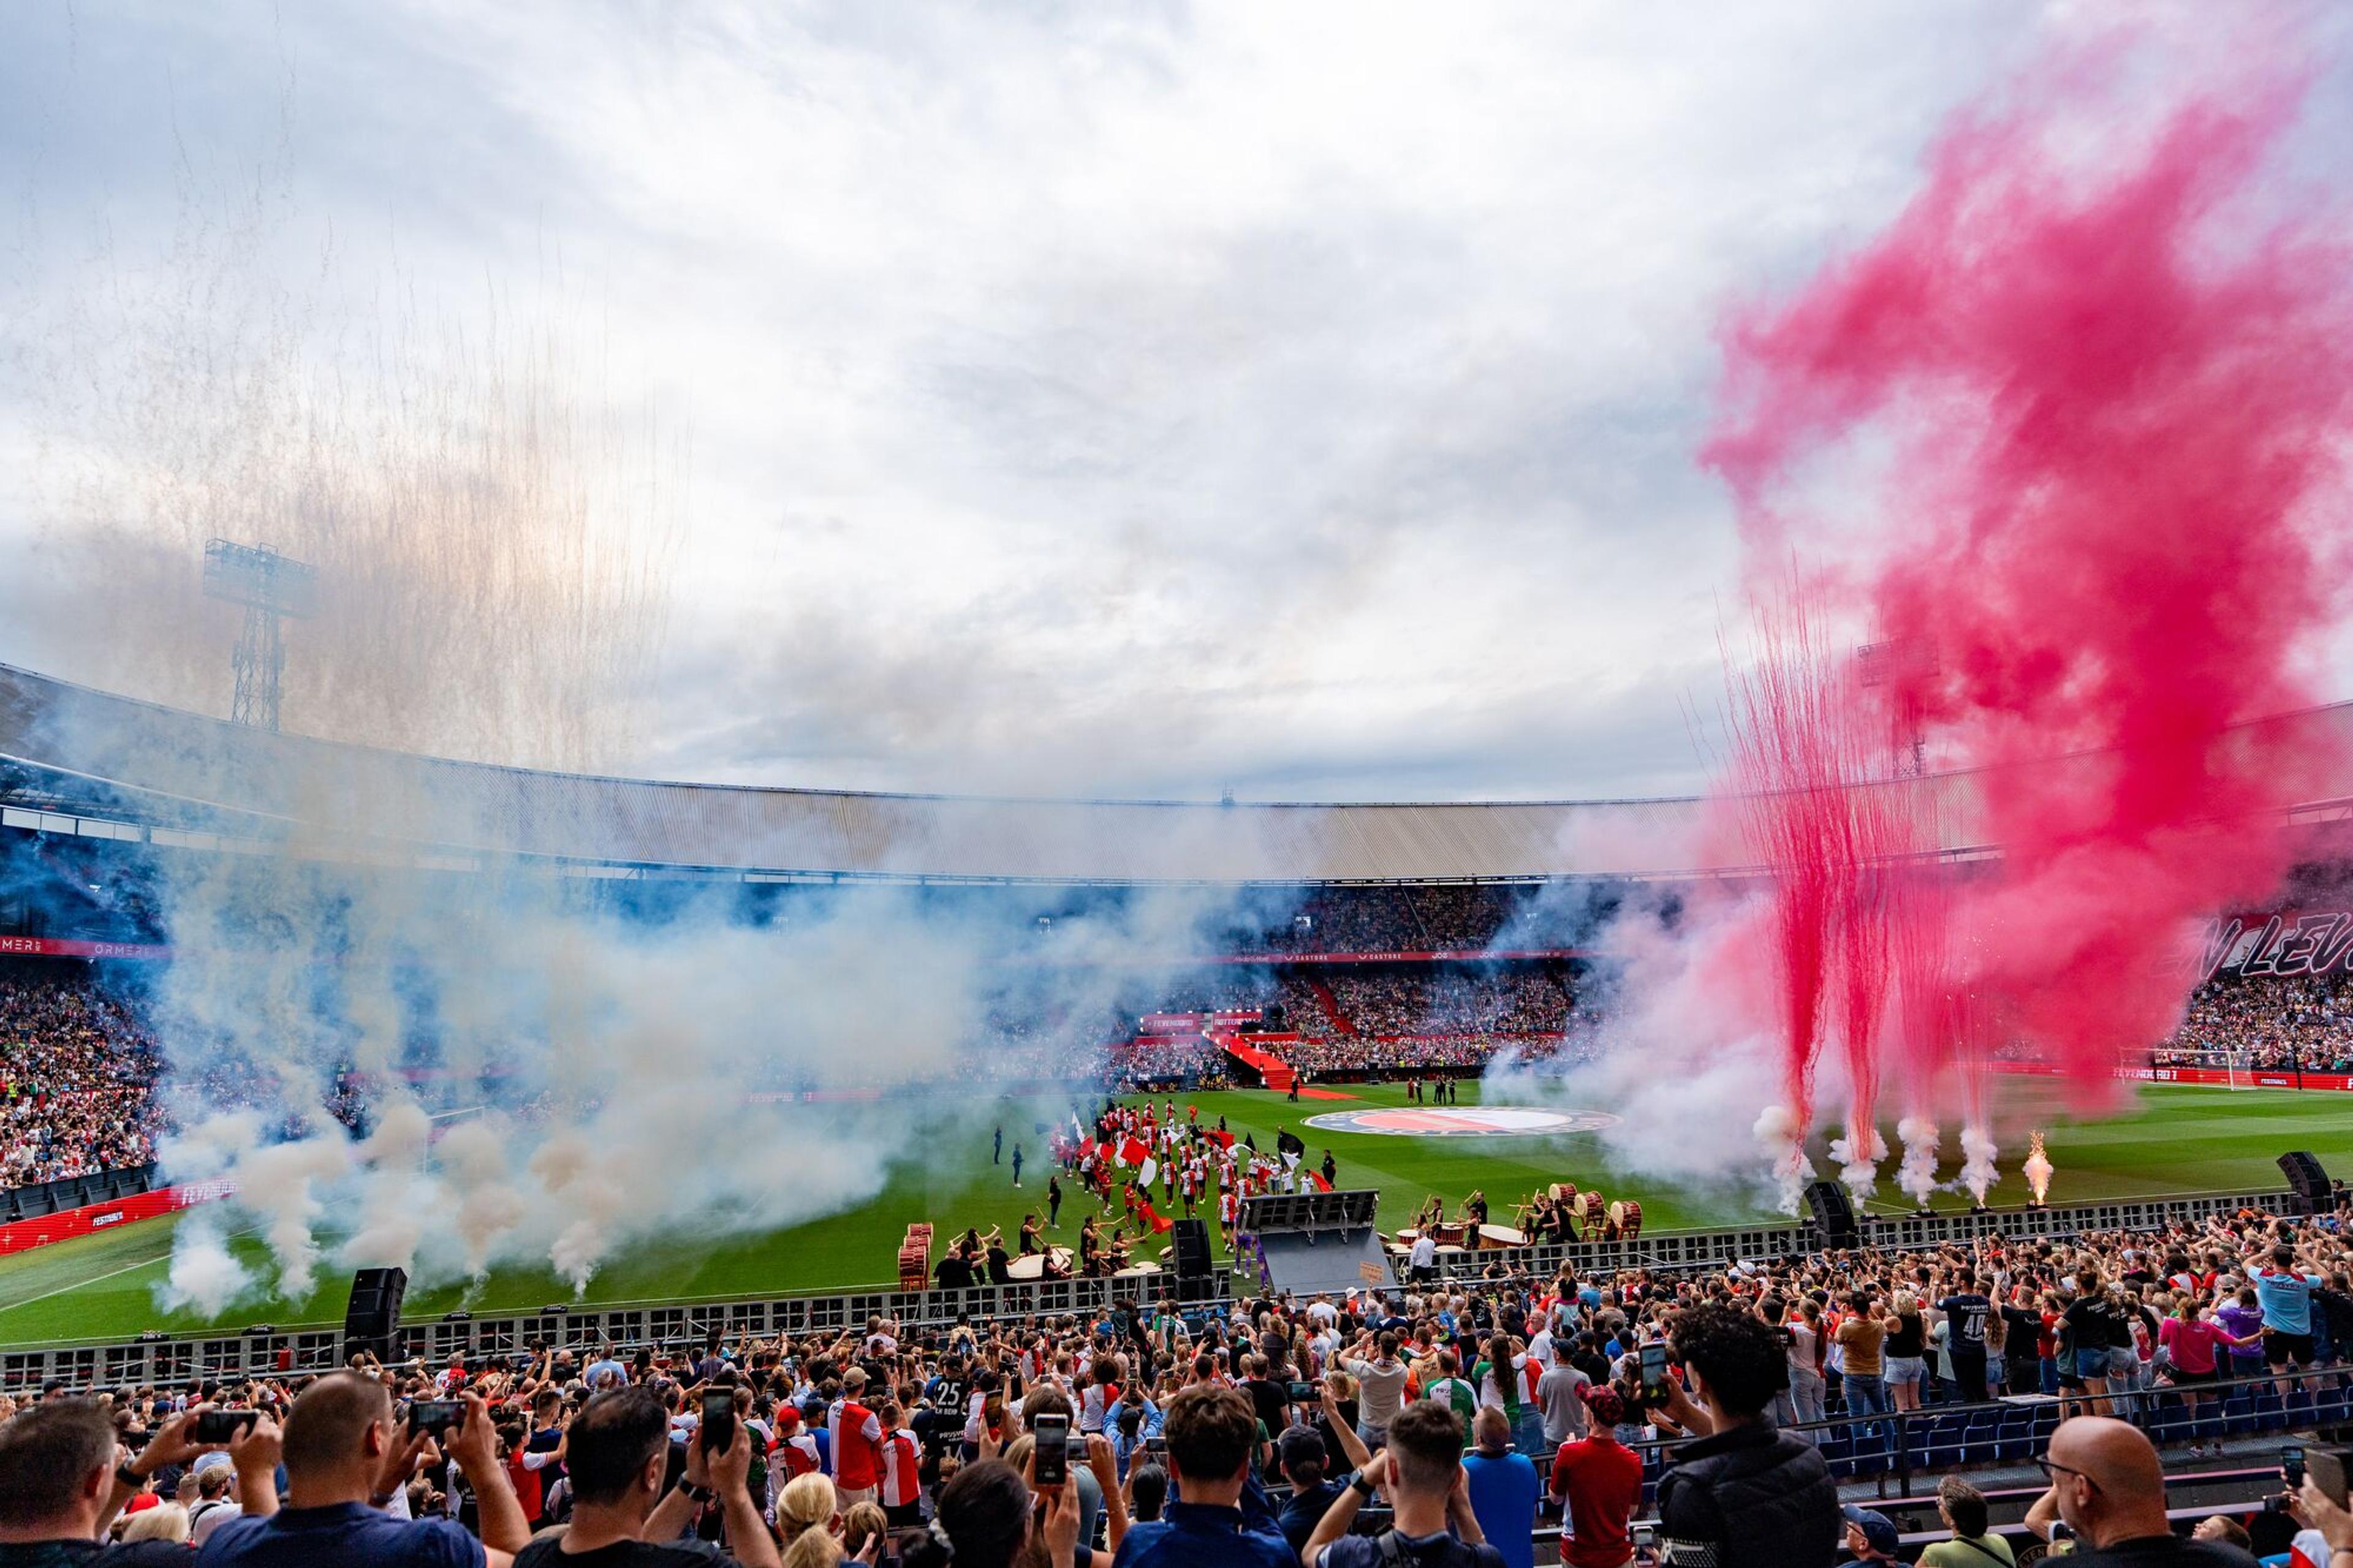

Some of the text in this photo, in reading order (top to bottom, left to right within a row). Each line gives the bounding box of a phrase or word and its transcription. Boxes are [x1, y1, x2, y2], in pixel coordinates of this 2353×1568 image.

[2240, 911, 2353, 975] LEV
[1963, 1314, 1986, 1336] 40
[937, 1382, 961, 1406] 25
